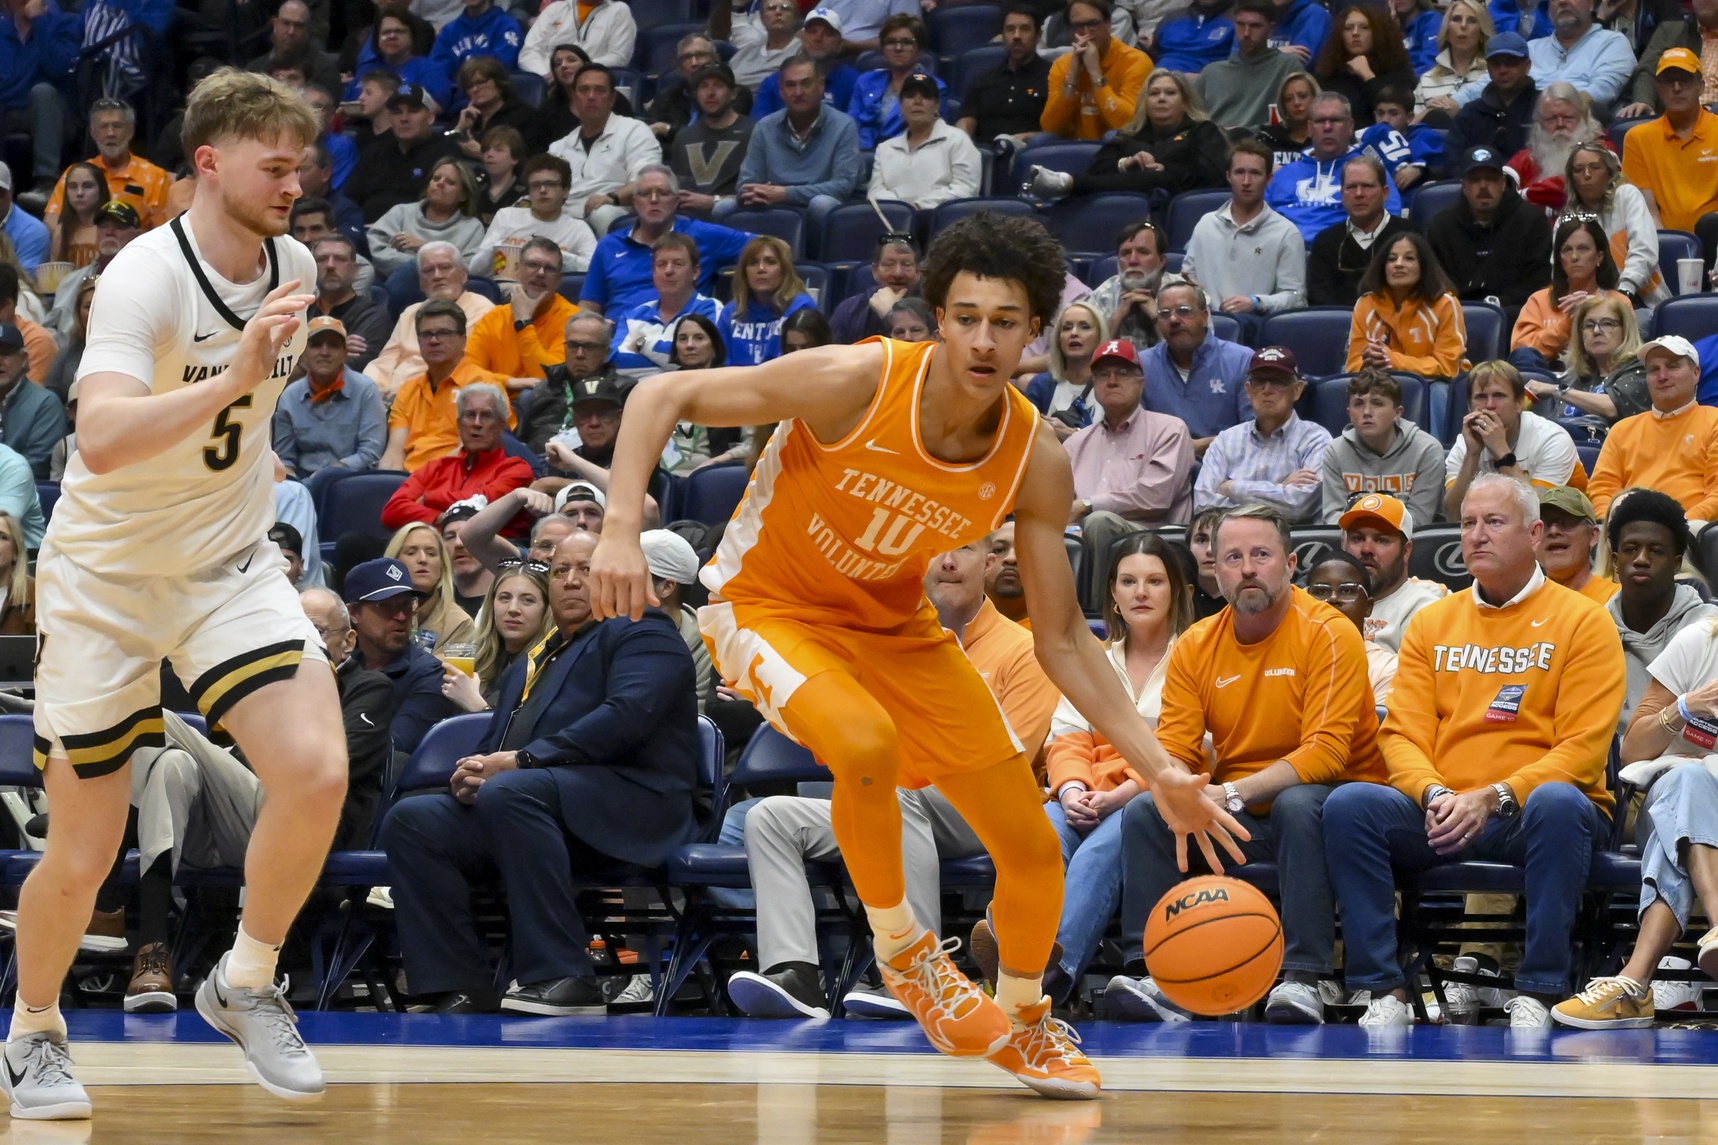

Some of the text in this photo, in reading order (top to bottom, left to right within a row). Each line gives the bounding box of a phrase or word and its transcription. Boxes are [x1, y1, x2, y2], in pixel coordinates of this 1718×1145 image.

[684, 140, 740, 186] V
[202, 392, 254, 474] 5
[834, 467, 973, 541] TENNESSEE
[853, 506, 927, 556] 10
[1433, 641, 1556, 675] TENNESSEE
[1685, 730, 1705, 742] GAME
[1165, 888, 1230, 923] NCAA
